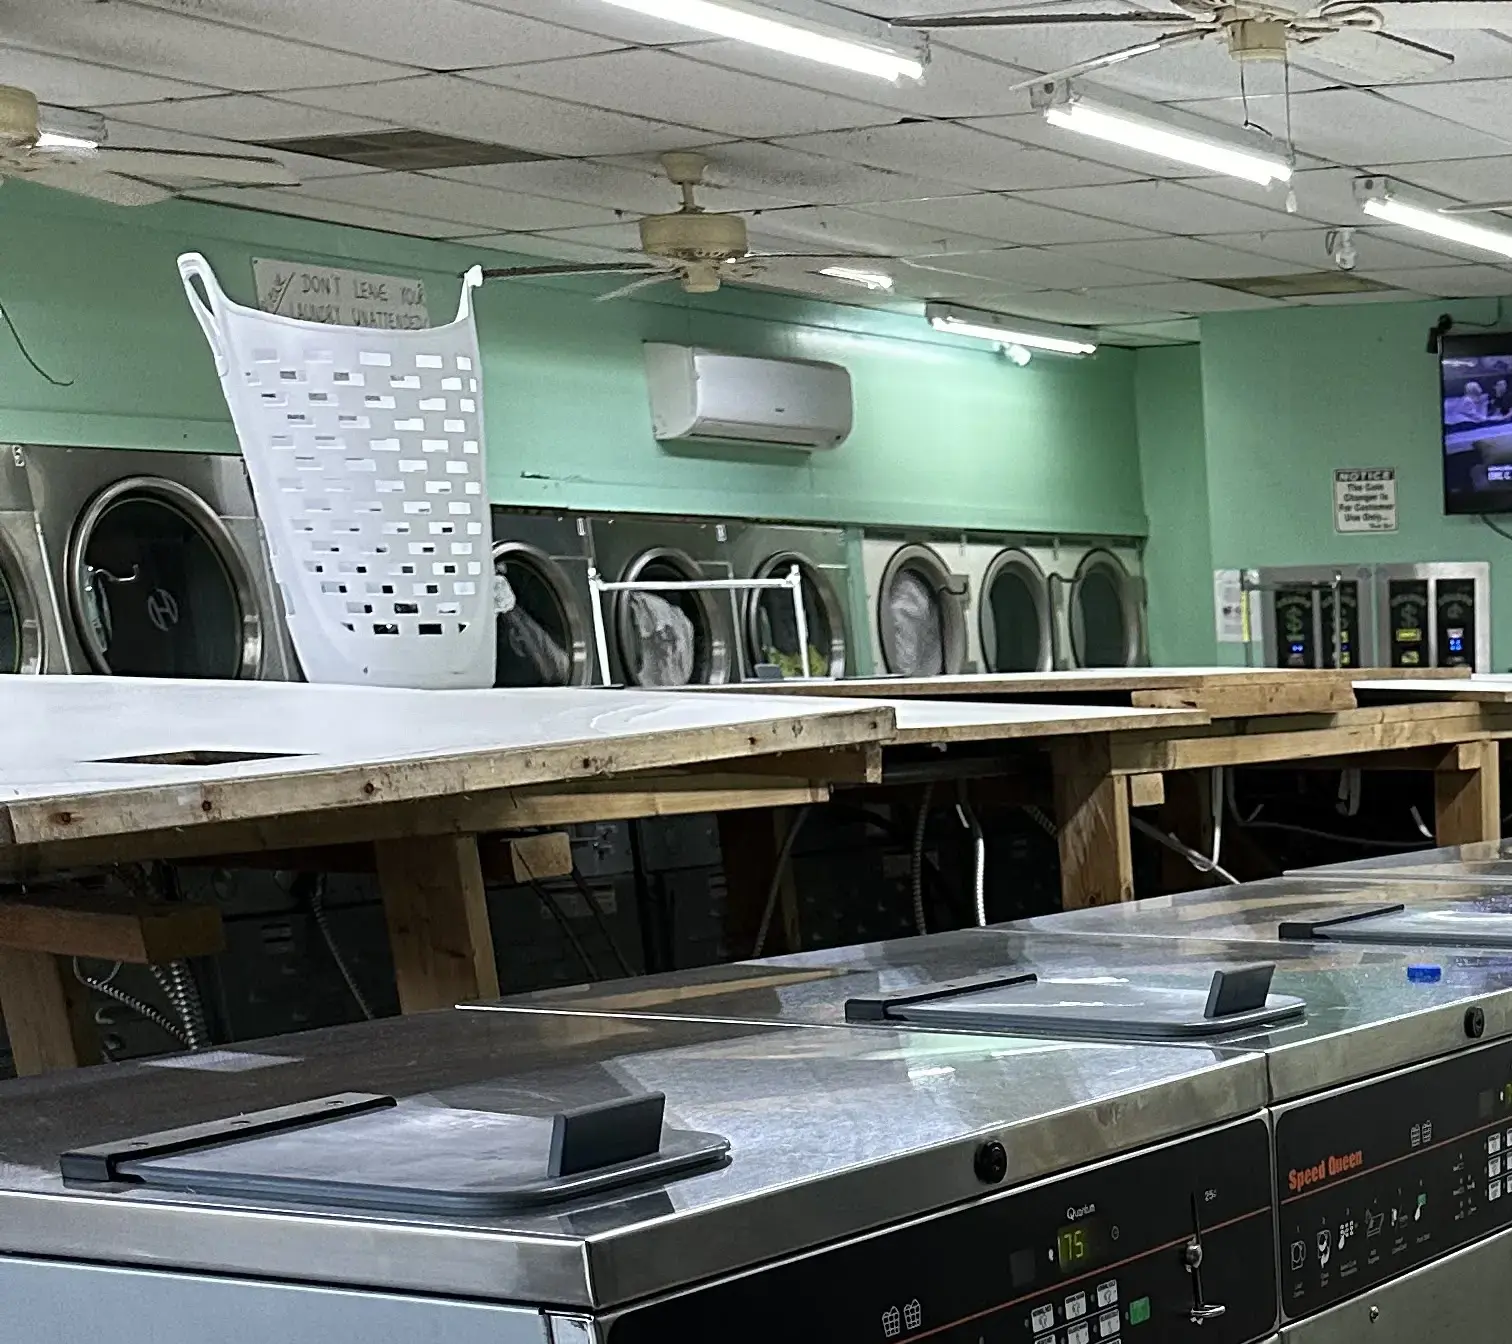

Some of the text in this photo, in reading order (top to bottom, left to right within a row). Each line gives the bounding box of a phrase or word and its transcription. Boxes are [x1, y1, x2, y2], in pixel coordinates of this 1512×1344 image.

[300, 273, 341, 295] DON'T
[353, 279, 387, 301] LEAVE
[1339, 471, 1390, 481] NOTICE
[1288, 1150, 1363, 1192] Speed Queen
[1066, 1203, 1096, 1221] Quantum
[1063, 1229, 1084, 1261] 75
